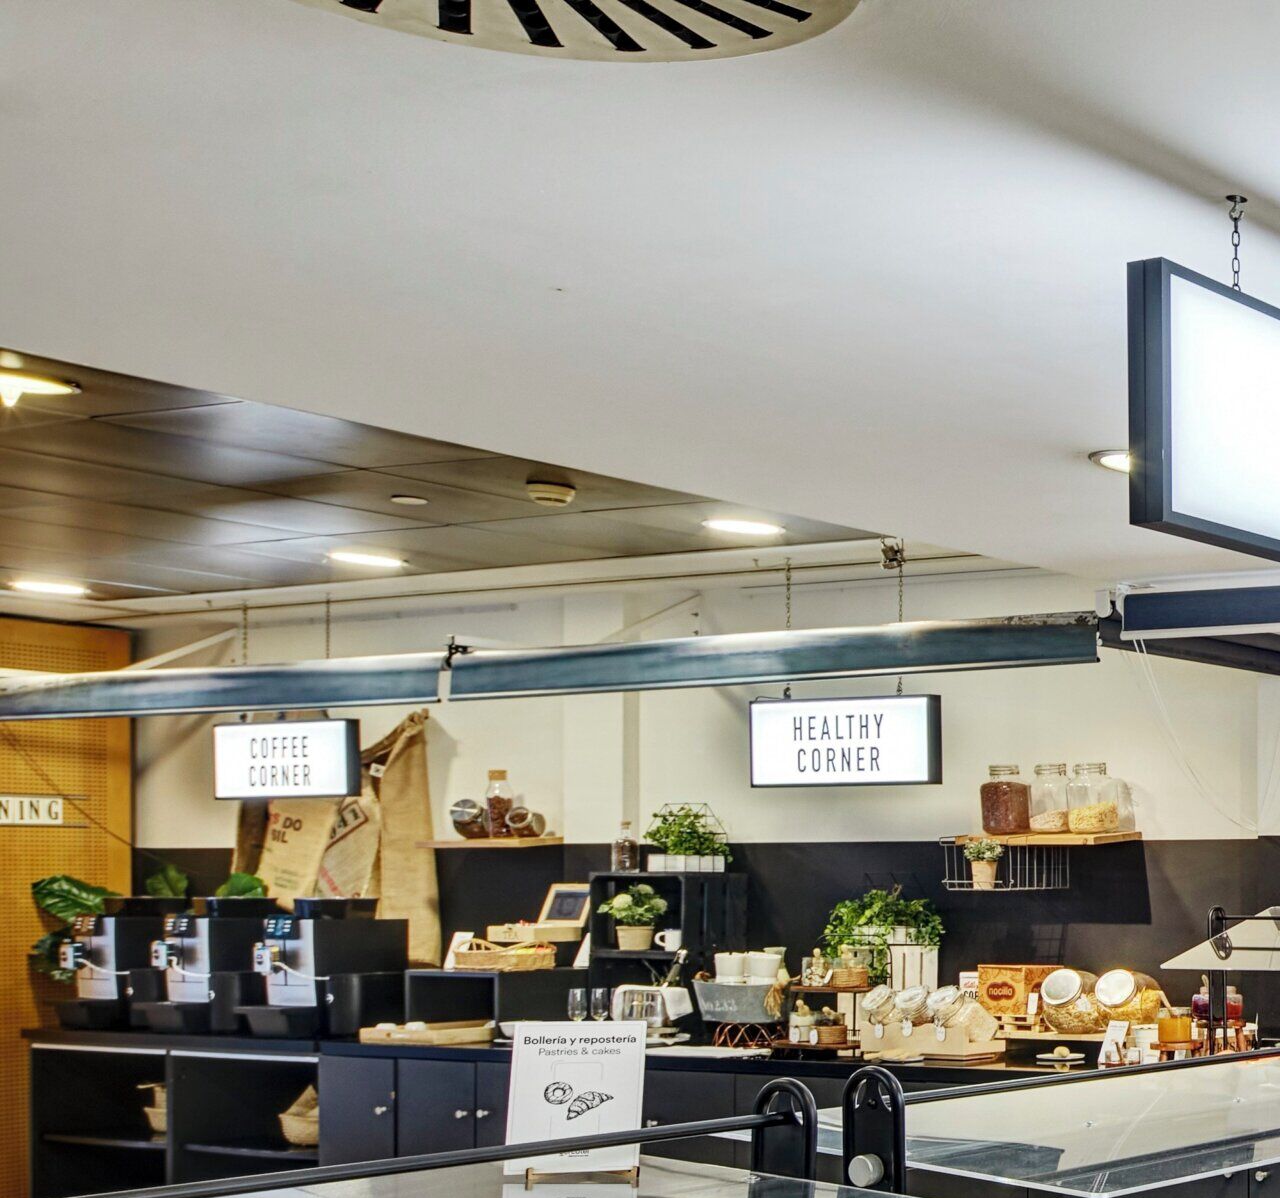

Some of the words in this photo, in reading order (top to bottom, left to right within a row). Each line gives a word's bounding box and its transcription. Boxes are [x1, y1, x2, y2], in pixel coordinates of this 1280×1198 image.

[792, 713, 885, 742] HEALTHY
[250, 735, 309, 759] COFFEE
[797, 746, 882, 774] CORNER
[248, 764, 312, 787] CORNER
[988, 986, 1013, 996] nocilla
[523, 1034, 568, 1046] Bollería
[578, 1033, 638, 1046] repostería
[537, 1047, 579, 1058] Pastries
[581, 1047, 589, 1056] &
[591, 1046, 622, 1057] cakes
